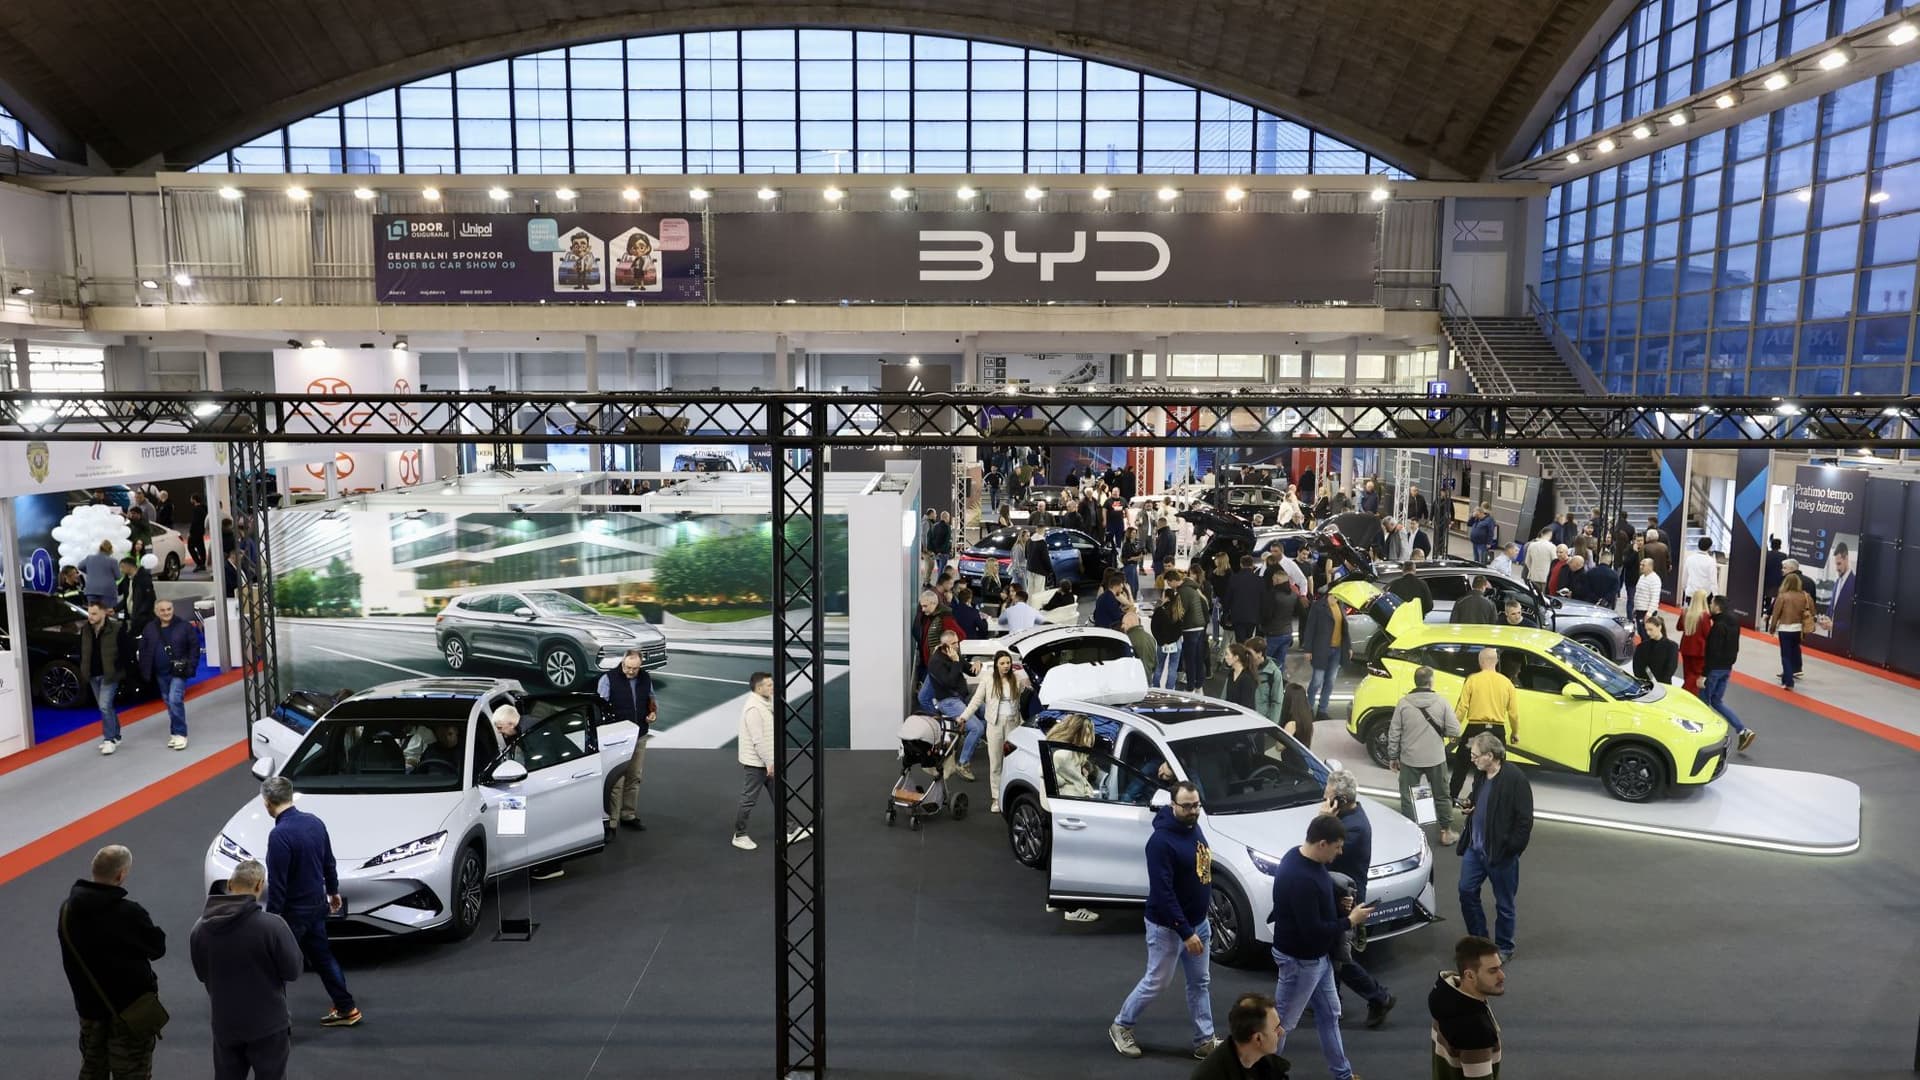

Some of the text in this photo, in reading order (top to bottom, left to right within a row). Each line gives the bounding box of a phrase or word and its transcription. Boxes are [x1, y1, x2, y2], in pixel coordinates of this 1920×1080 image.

[411, 222, 493, 238] DDOR Unipol
[387, 251, 504, 260] GENERALNI SPONZOR
[919, 230, 1171, 281] BYD
[388, 261, 516, 270] DDOR BG CAR SHOW 09
[141, 444, 198, 458] ПУТЕВИ СРБИЈЕ
[1796, 484, 1854, 503] Pratimo tempo
